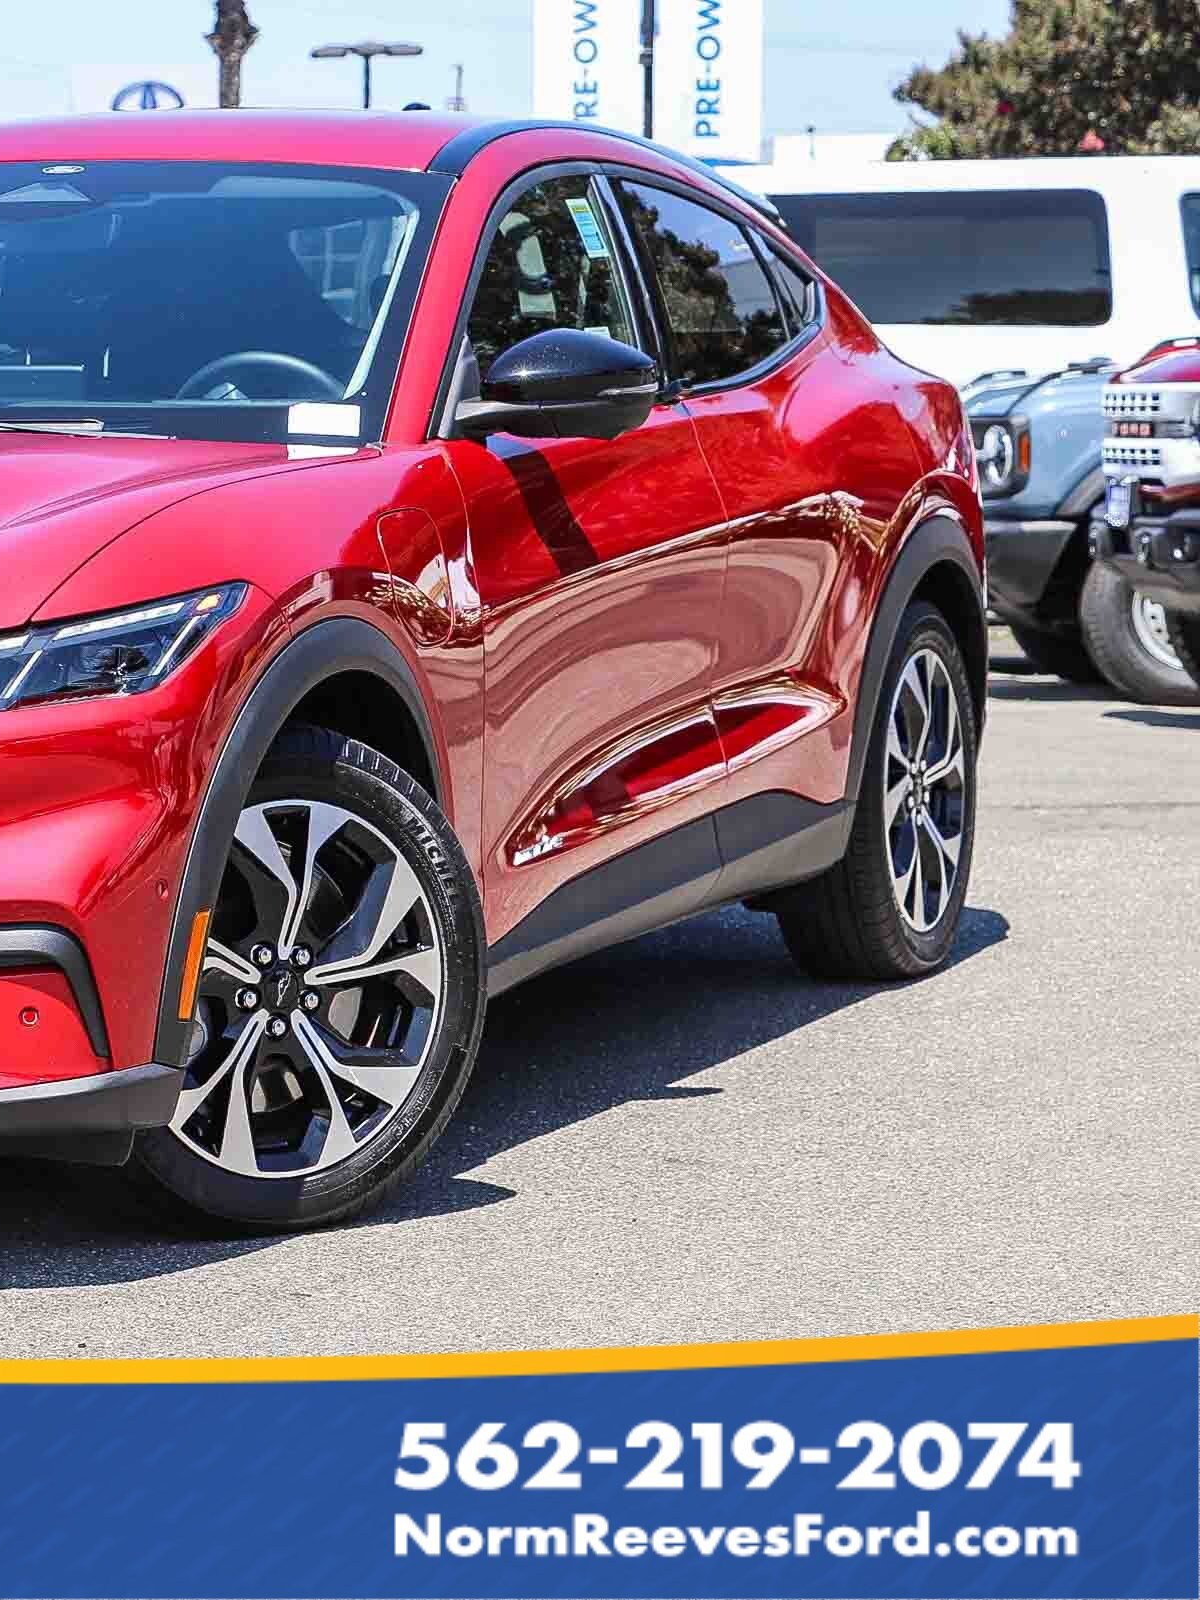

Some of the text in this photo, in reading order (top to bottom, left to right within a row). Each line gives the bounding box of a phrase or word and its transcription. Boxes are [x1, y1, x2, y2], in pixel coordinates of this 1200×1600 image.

[574, 0, 598, 120] RE-OW
[696, 0, 721, 137] PRE-OW
[401, 815, 465, 906] MICHEL
